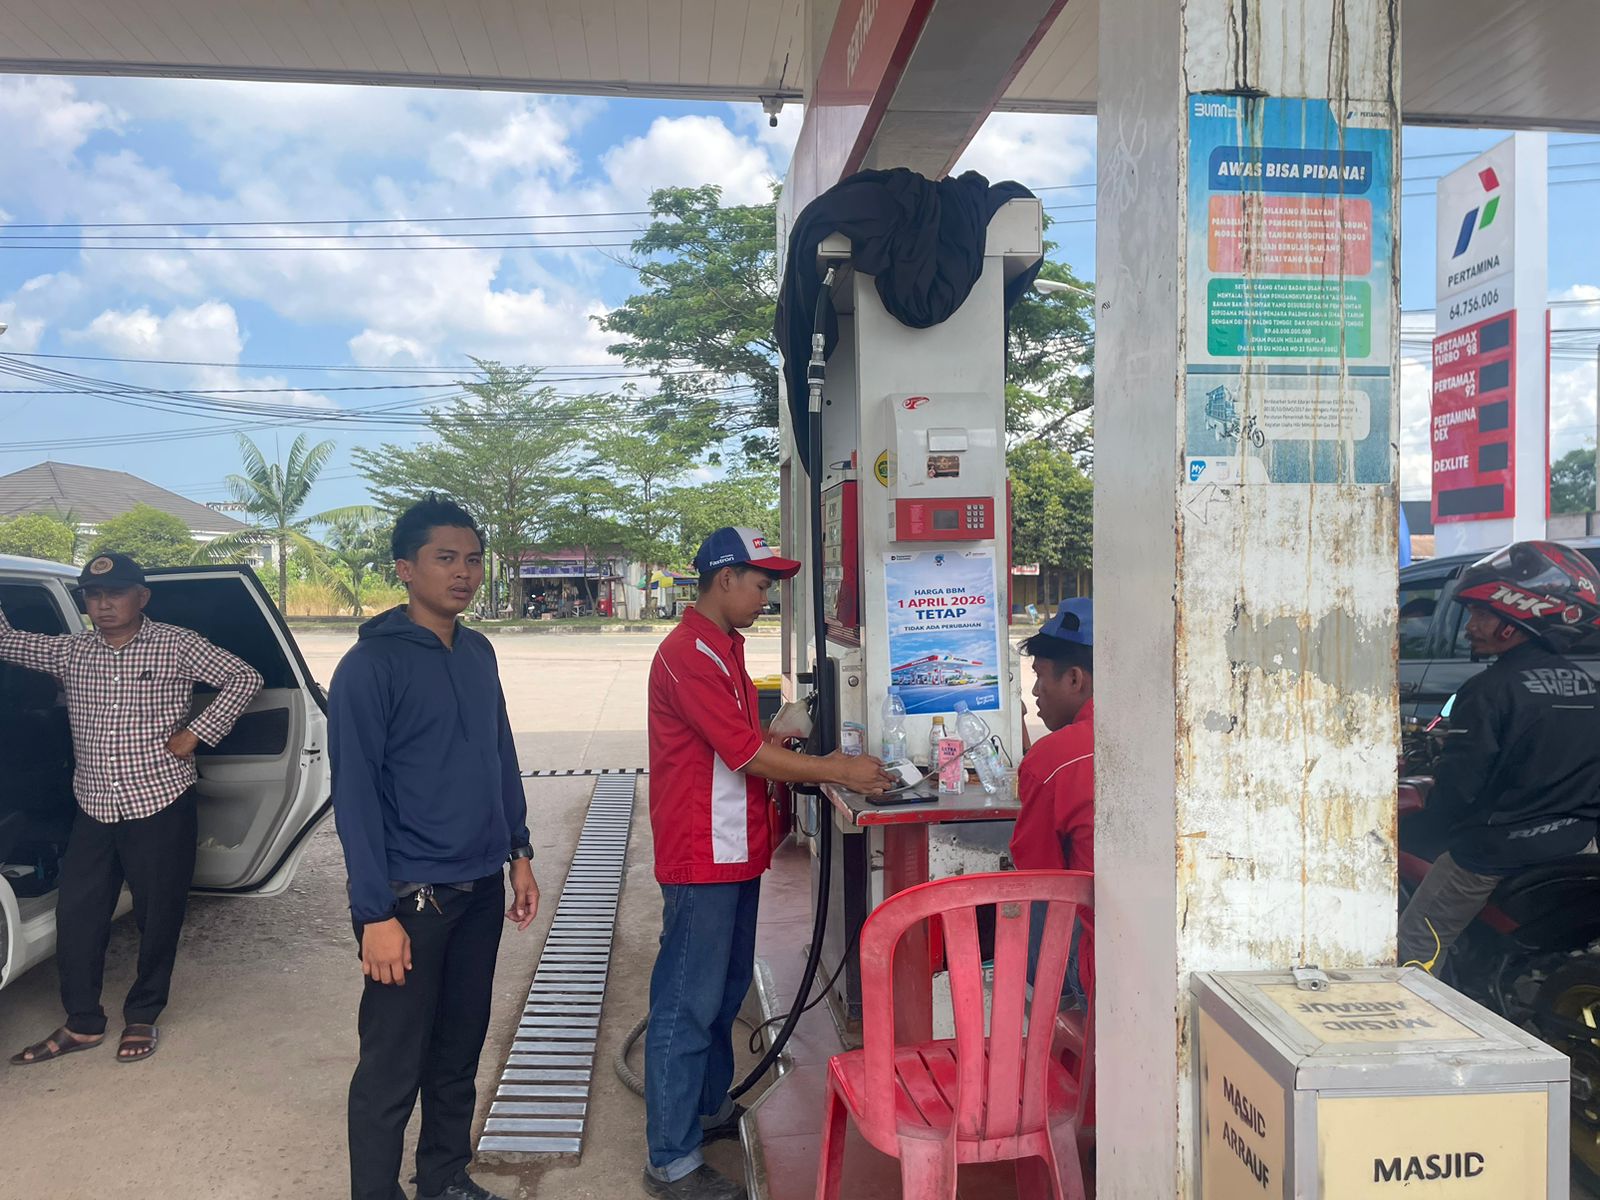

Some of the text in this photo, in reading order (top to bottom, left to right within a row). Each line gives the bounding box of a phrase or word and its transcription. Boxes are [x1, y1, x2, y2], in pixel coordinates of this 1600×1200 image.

[1217, 161, 1366, 181] AWAS BISA PIDANA!
[1263, 207, 1299, 216] DILARANG
[1300, 208, 1336, 217] MELAYANI
[1283, 256, 1303, 264] YANG
[1448, 255, 1500, 287] PERTAMINA
[1449, 289, 1500, 320] 64.756.006
[1434, 330, 1478, 357] PERTAMAX
[1434, 343, 1478, 367] TURBO 98
[1434, 370, 1476, 394] PERTAMAX
[1464, 384, 1476, 398] 92
[1434, 407, 1477, 429] PERTAMINA
[1434, 427, 1449, 442] DEX
[1434, 455, 1470, 473] DEXLITE
[709, 556, 735, 567] Fastron
[914, 588, 944, 596] HARGA
[898, 595, 986, 608] 1 APRIL 2026
[1490, 586, 1554, 618] NHK
[915, 608, 967, 620] TETAP
[941, 622, 982, 630] PERUBAHAN
[1295, 1001, 1408, 1014] ARRAUF
[1323, 1016, 1434, 1032] MASJID
[1223, 1075, 1267, 1139] MASJID
[1222, 1120, 1270, 1190] ARRAUF
[1373, 1151, 1485, 1183] MASJID
